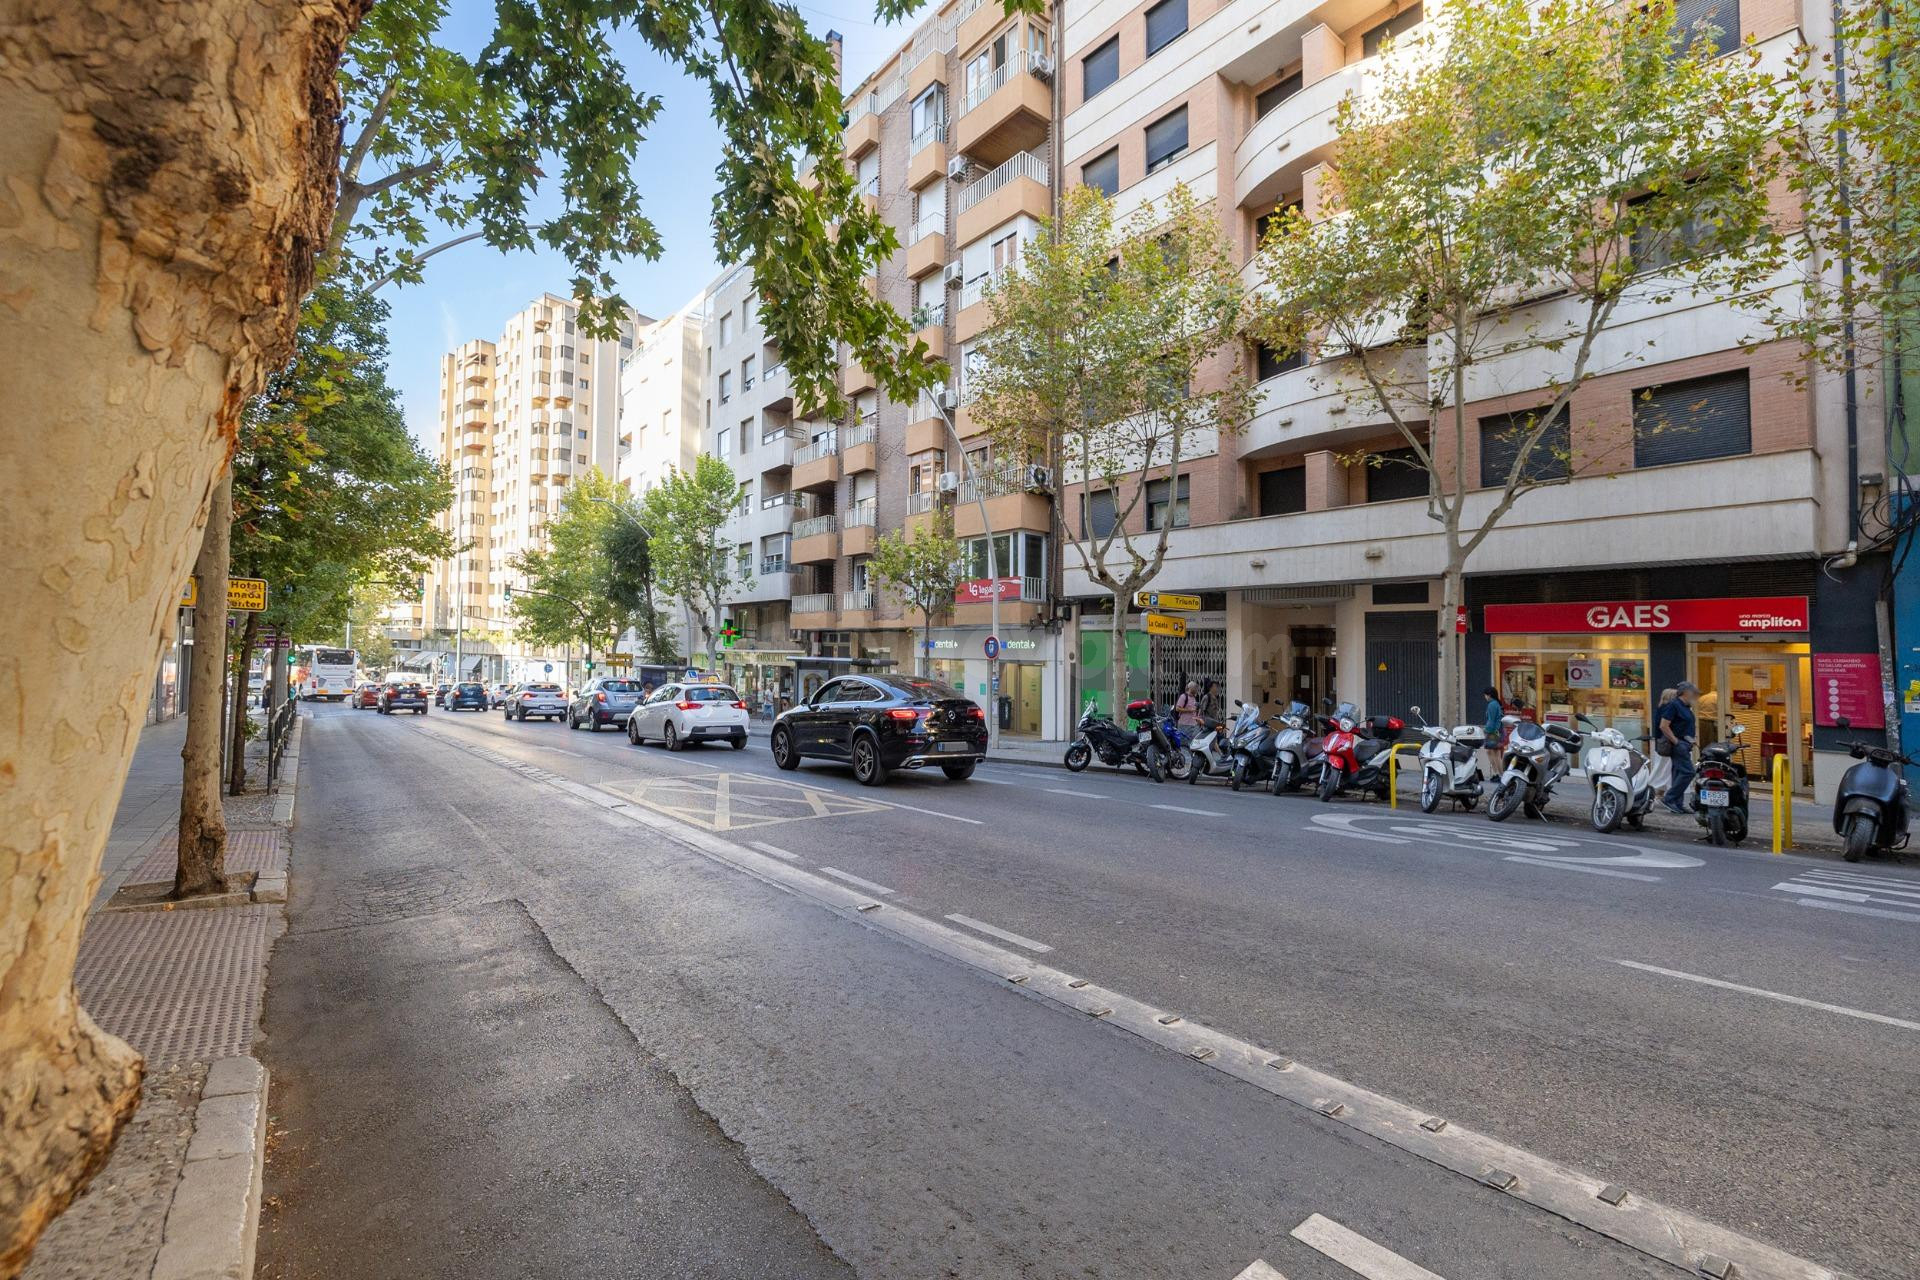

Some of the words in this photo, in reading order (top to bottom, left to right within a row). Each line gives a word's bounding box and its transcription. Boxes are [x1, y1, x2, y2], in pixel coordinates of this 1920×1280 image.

[231, 581, 262, 590] Hotel
[227, 591, 261, 599] anada
[227, 599, 262, 608] enter
[1175, 597, 1200, 606] Triunfo
[1586, 604, 1671, 628] GAES
[1738, 616, 1802, 630] amplifon
[935, 640, 954, 649] dental
[1007, 640, 1031, 649] dental
